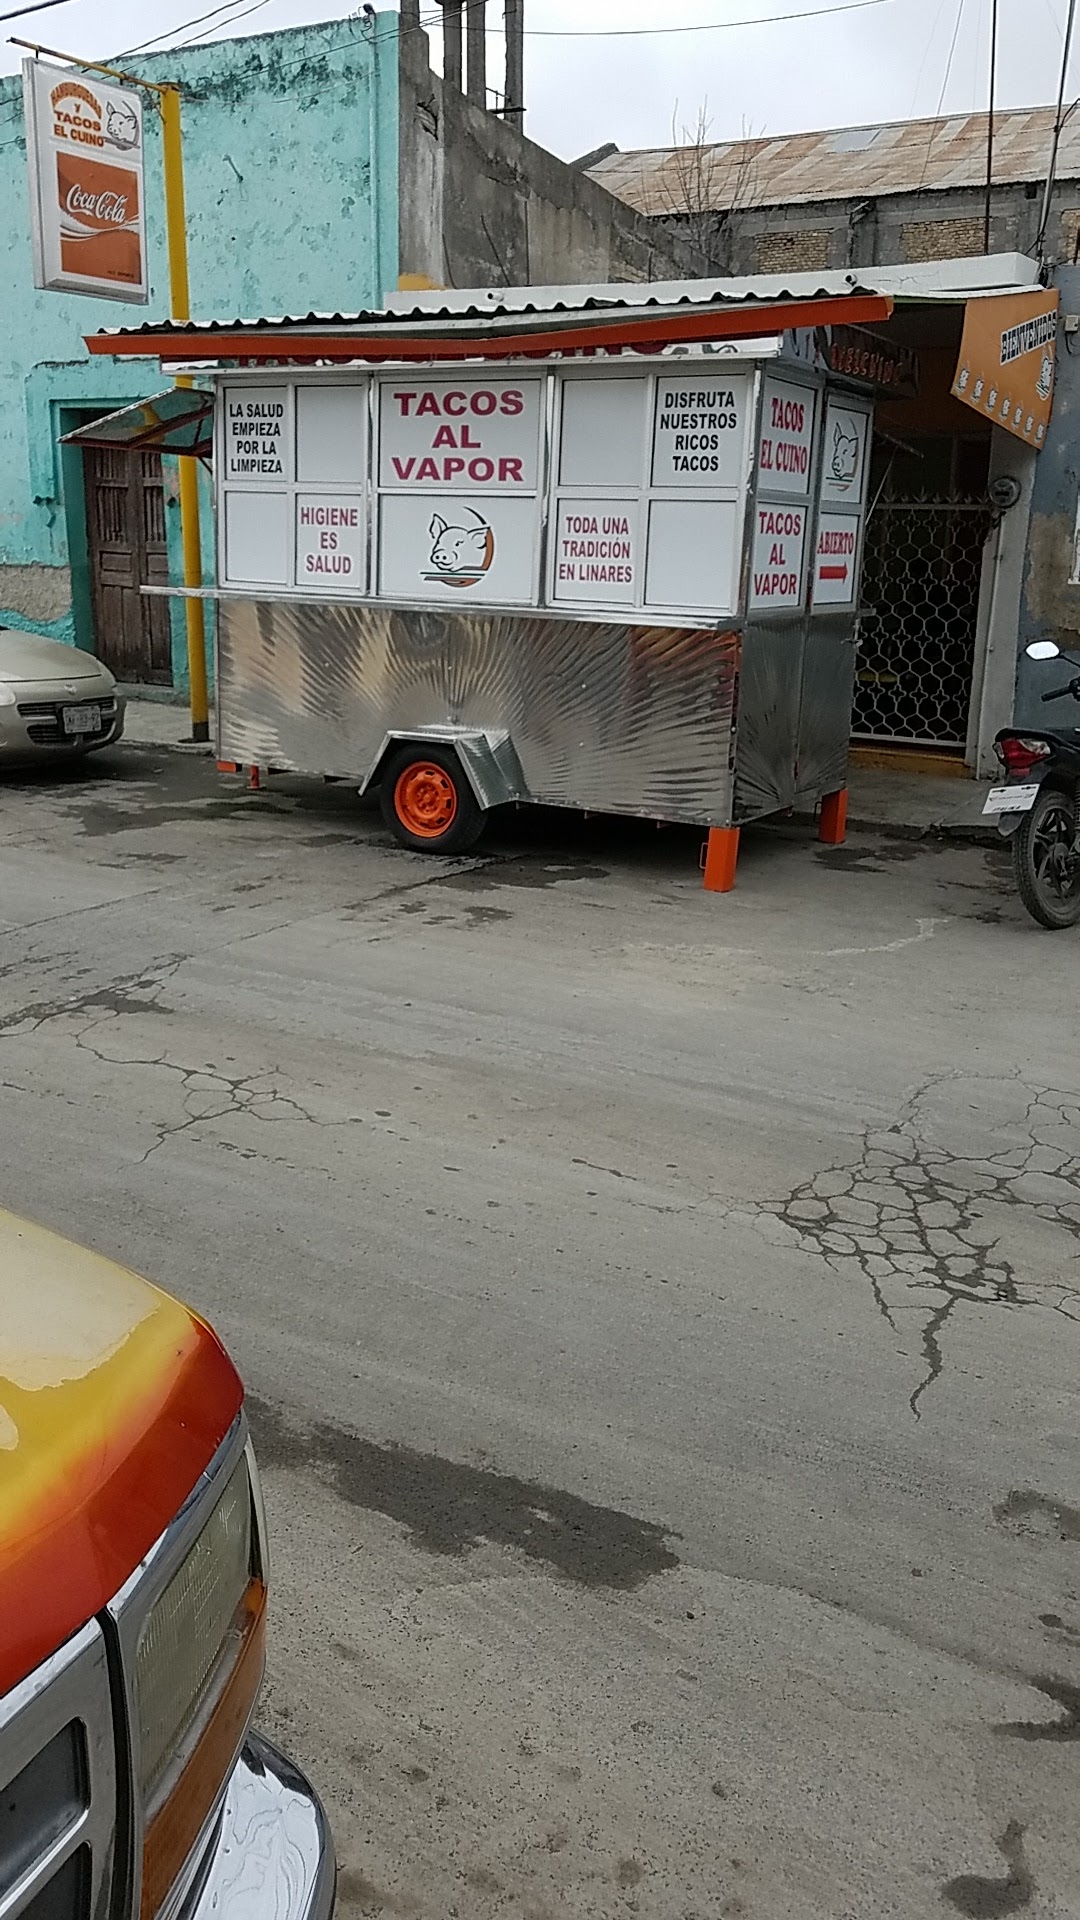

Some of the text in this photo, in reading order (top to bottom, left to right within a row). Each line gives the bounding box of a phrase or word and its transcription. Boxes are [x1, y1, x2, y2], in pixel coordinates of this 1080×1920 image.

[54, 110, 101, 131] TACOS
[54, 124, 104, 147] EL CUINO
[1001, 311, 1057, 363] BIENVENIDOS
[393, 391, 523, 416] TACOS
[665, 391, 734, 408] DISFRUTA
[230, 404, 284, 418] LA SALUD
[660, 413, 737, 429] NUESTROS
[771, 398, 804, 433] TACOS
[232, 422, 281, 436] EMPIEZA
[432, 425, 481, 449] AL
[237, 441, 276, 454] POR LA
[675, 434, 718, 450] RICOS
[231, 459, 282, 473] LIMPIEZA
[673, 455, 719, 472] TACOS
[760, 439, 808, 475] EL CUINO
[392, 457, 523, 481] VAPOR
[301, 507, 358, 526] HIGIENE
[566, 517, 628, 535] TODA UNA
[759, 511, 801, 536] TACOS
[320, 531, 337, 549] ES
[563, 537, 630, 559] TRADICIÓN
[817, 531, 854, 555] ABIERTO
[769, 543, 786, 565] AL
[306, 555, 352, 574] SALUD
[559, 563, 632, 582] EN LINARES
[754, 573, 797, 596] VAPOR
